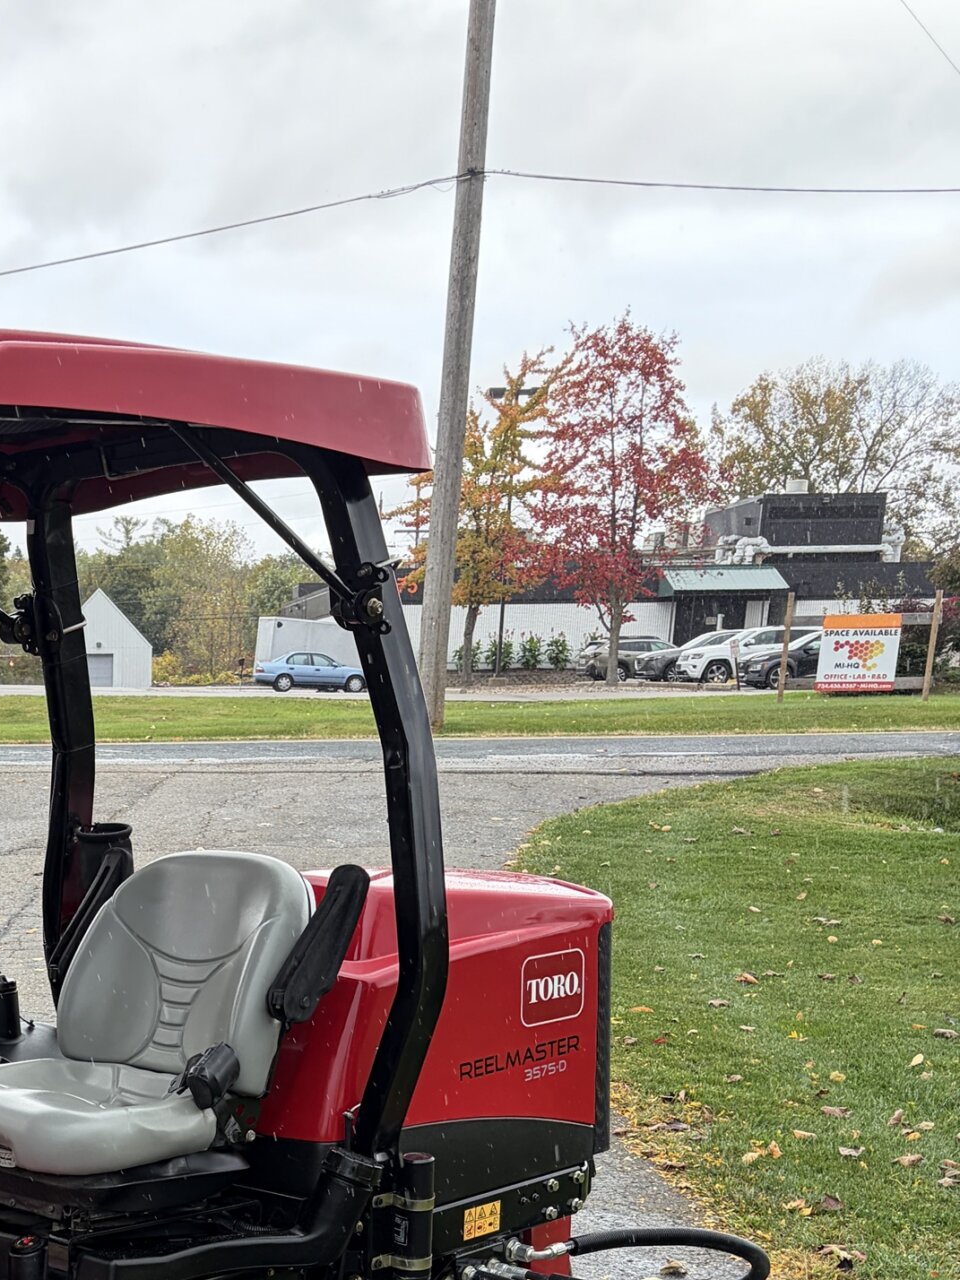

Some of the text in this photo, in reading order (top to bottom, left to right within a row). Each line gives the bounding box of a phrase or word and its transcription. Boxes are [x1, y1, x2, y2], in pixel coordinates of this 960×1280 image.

[824, 629, 898, 637] SPACE AVAILABLE
[526, 971, 580, 1004] TORO
[459, 1034, 581, 1081] REELMASTER
